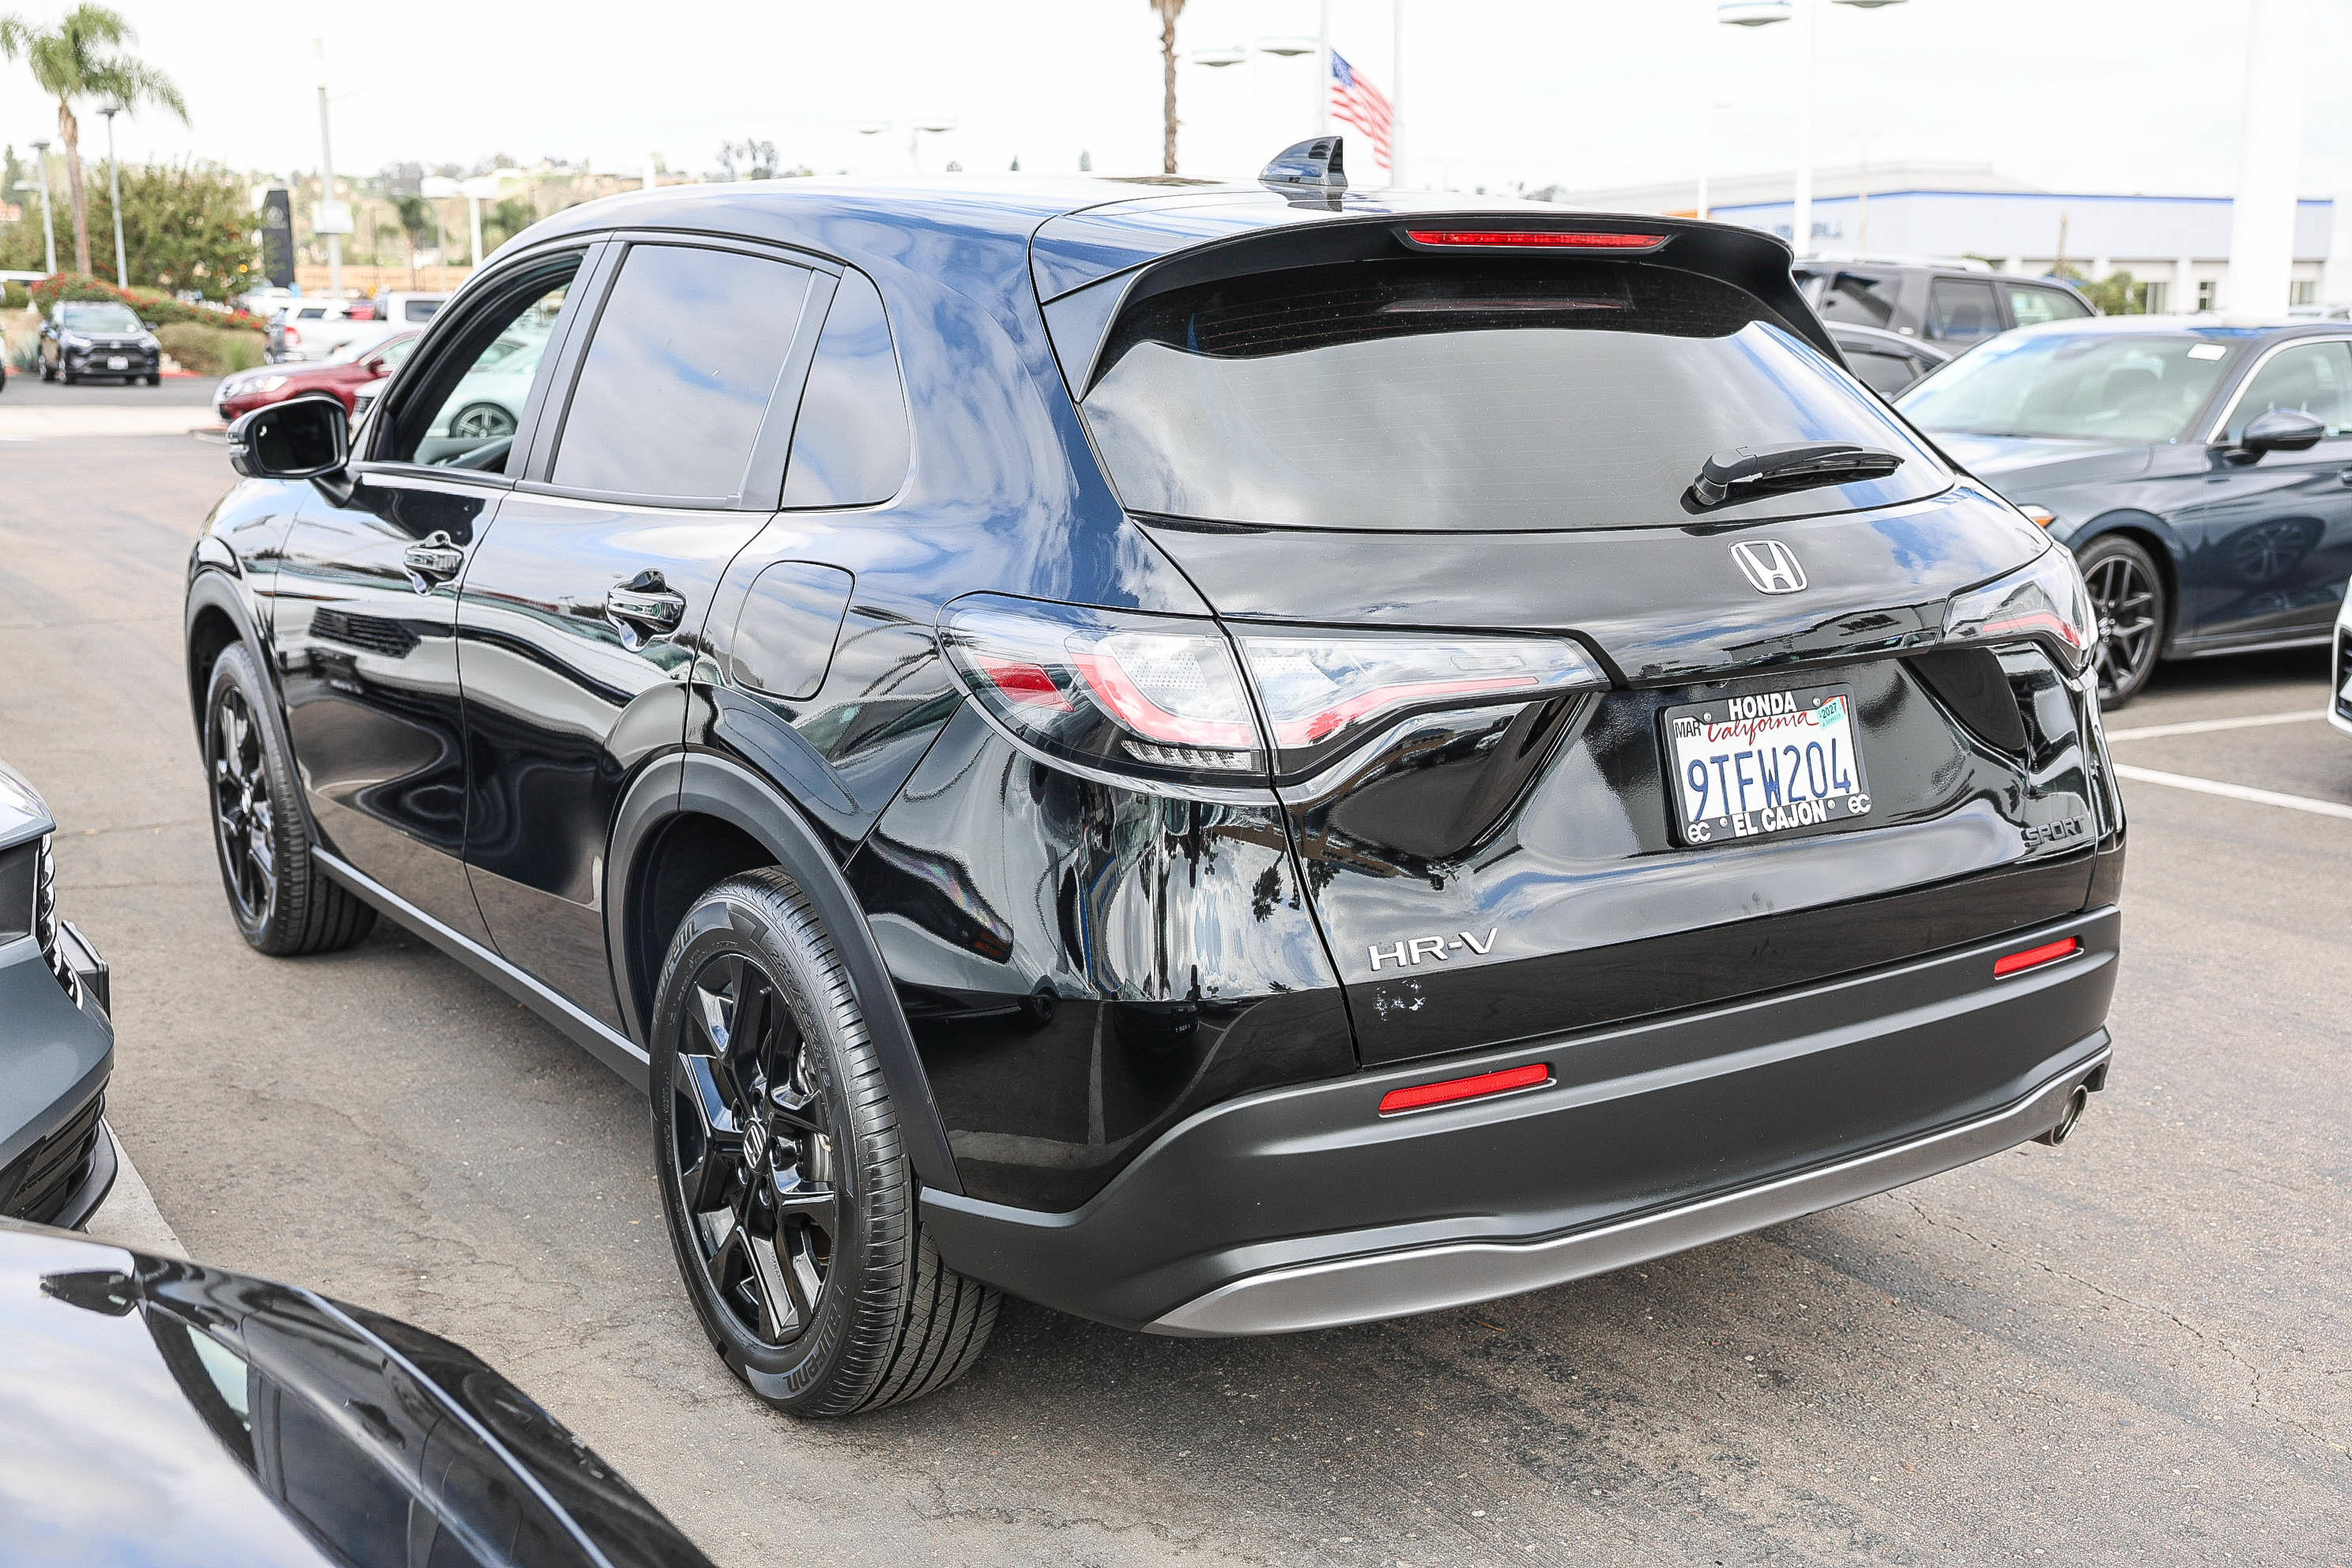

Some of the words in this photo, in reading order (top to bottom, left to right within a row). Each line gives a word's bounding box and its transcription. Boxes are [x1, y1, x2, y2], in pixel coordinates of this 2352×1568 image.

[1728, 692, 1798, 720] HONDA
[1821, 703, 1838, 719] 2027
[1675, 720, 1702, 739] MAR
[1707, 711, 1819, 746] California
[1687, 738, 1851, 822] 9TFW204
[1732, 814, 1759, 838] EL
[1761, 799, 1828, 832] CAJON
[2021, 815, 2085, 847] SPORT
[1367, 927, 1498, 971] HR-V
